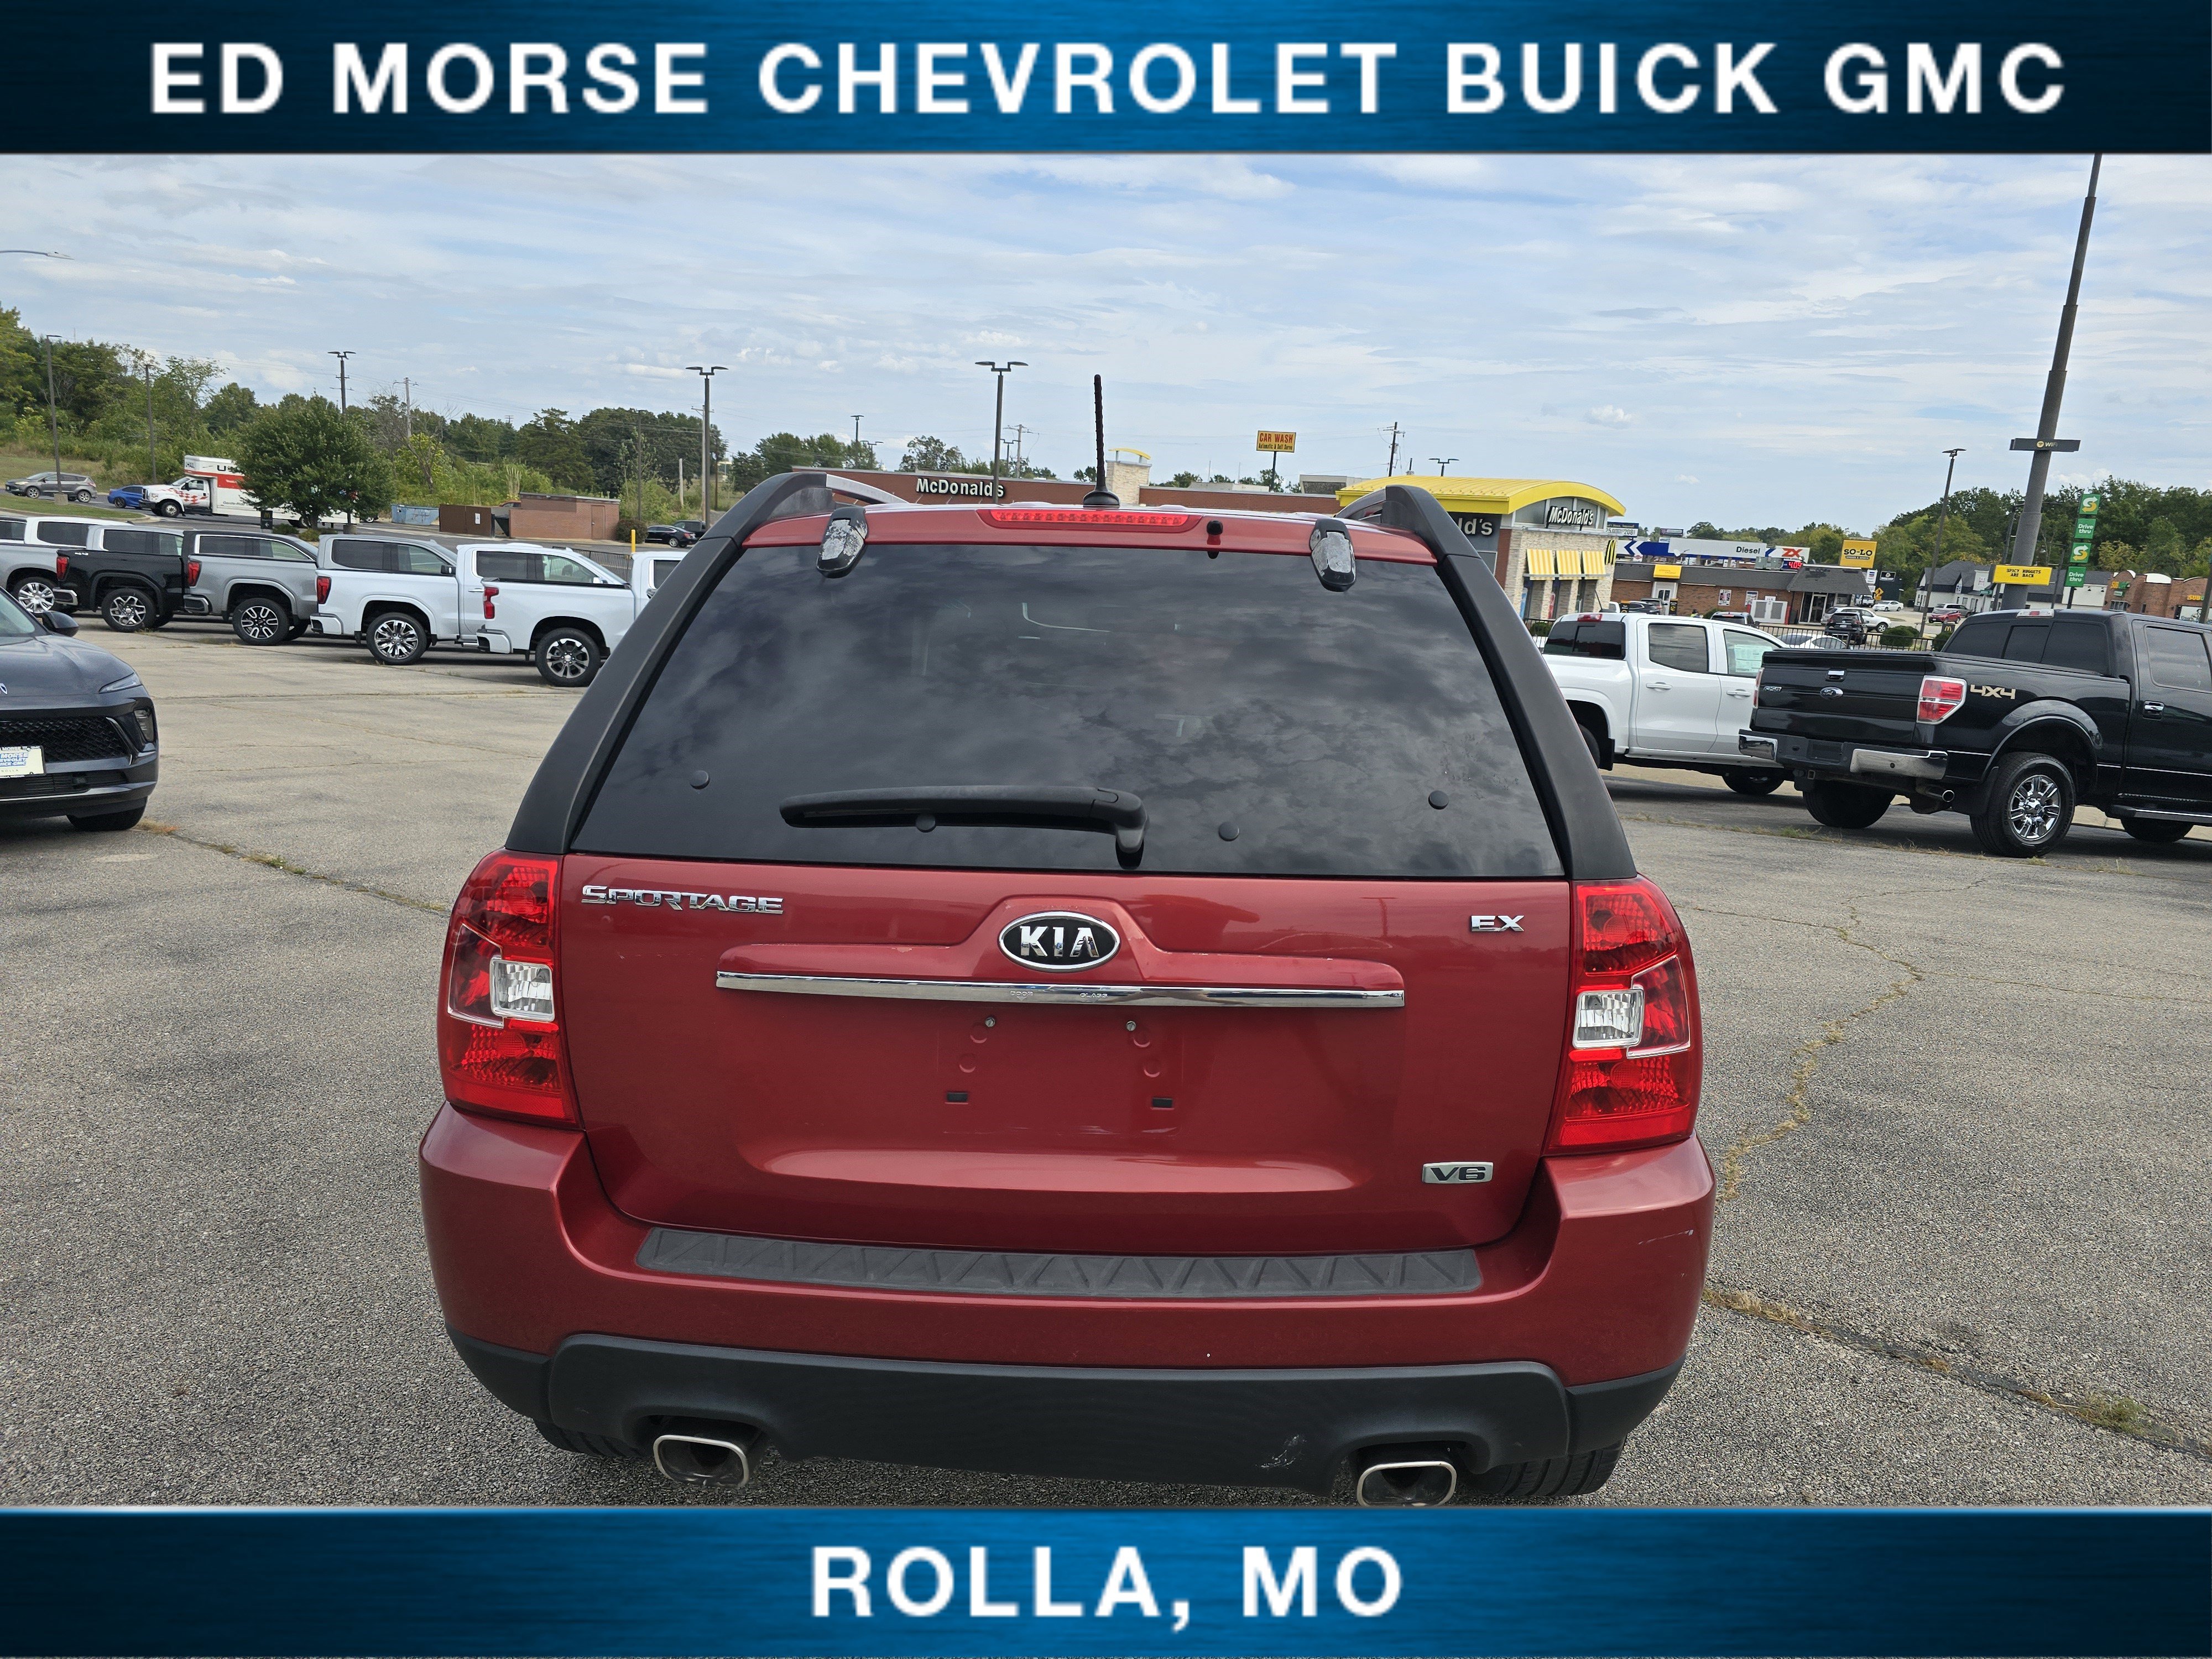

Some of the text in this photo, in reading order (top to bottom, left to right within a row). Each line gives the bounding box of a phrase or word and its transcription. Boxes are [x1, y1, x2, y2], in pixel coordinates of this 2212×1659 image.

[1260, 433, 1293, 443] CAR WASH
[1548, 507, 1594, 525] McDonald's
[1782, 547, 1803, 557] ZX
[581, 885, 784, 914] SPORTAGE
[1471, 915, 1525, 932] EX
[1019, 925, 1100, 958] KIA
[1430, 1166, 1486, 1181] V6
